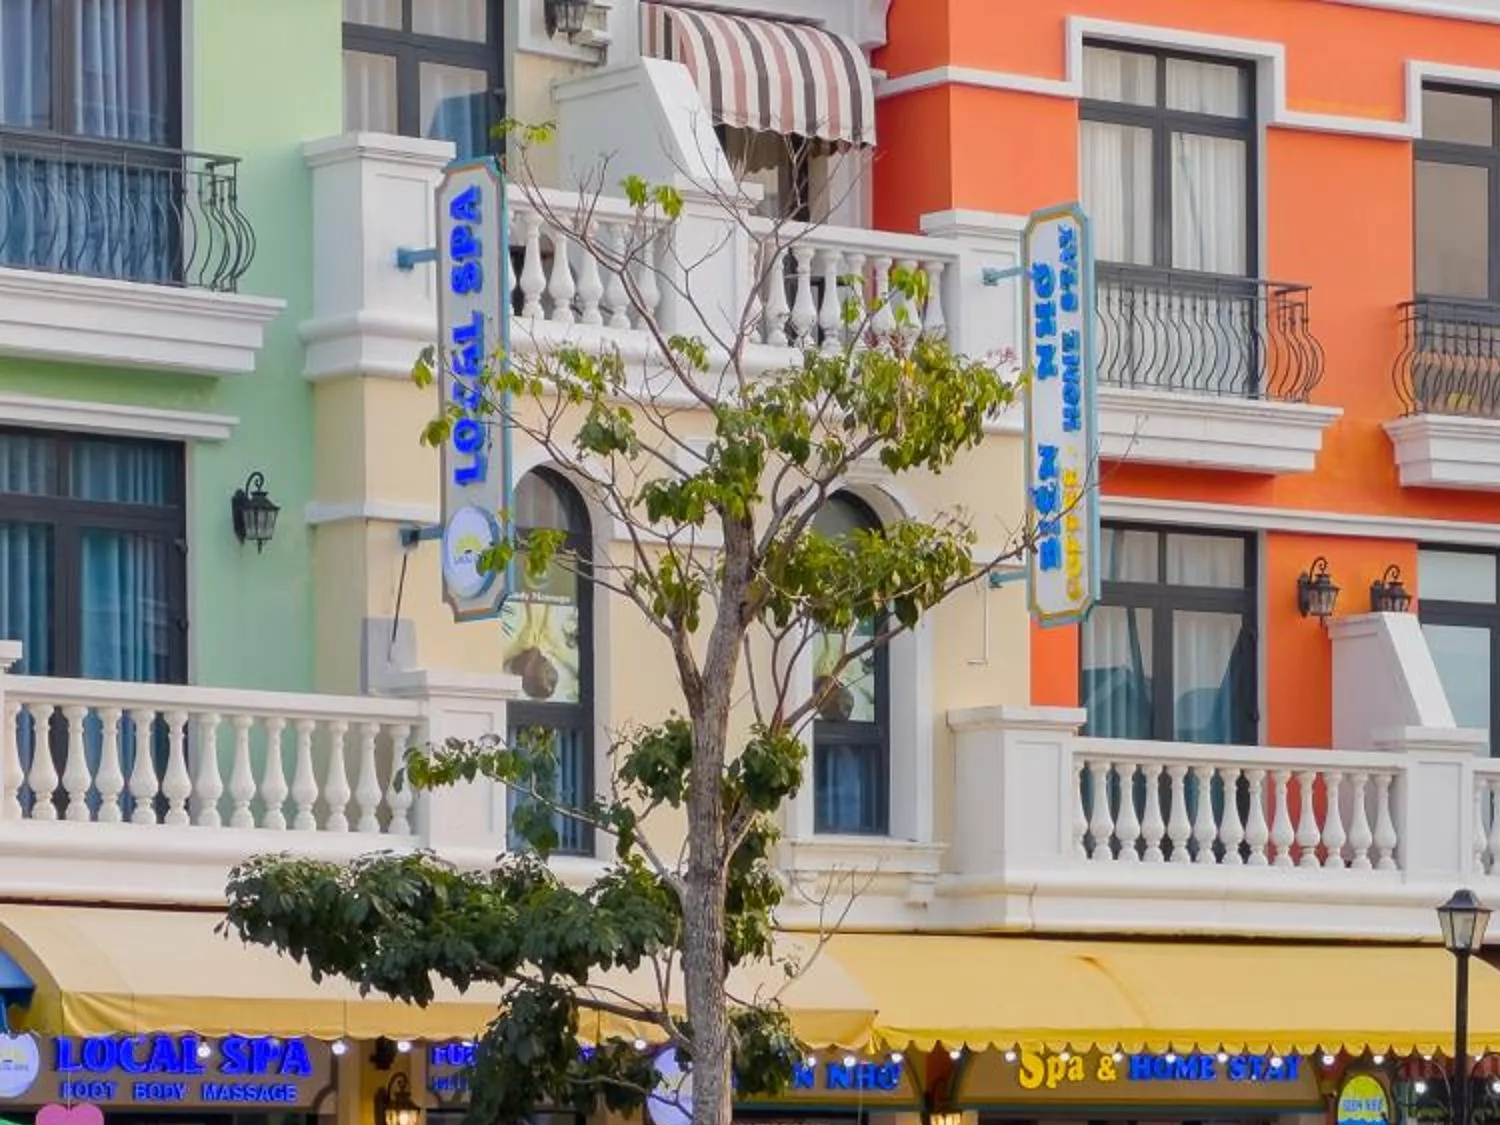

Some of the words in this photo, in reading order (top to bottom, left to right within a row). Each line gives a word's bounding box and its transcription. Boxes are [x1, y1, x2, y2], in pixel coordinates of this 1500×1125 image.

[450, 185, 483, 295] SPA
[452, 310, 486, 487] LOCAL
[1061, 330, 1082, 433] HOME
[54, 1035, 205, 1074] LOCAL
[220, 1036, 312, 1076] SPA
[61, 1081, 117, 1100] FOOT
[132, 1081, 189, 1101] BODY
[202, 1083, 297, 1102] MASSAGE
[1019, 1046, 1084, 1089] Spa
[1098, 1056, 1116, 1081] &
[1129, 1055, 1217, 1081] HOME
